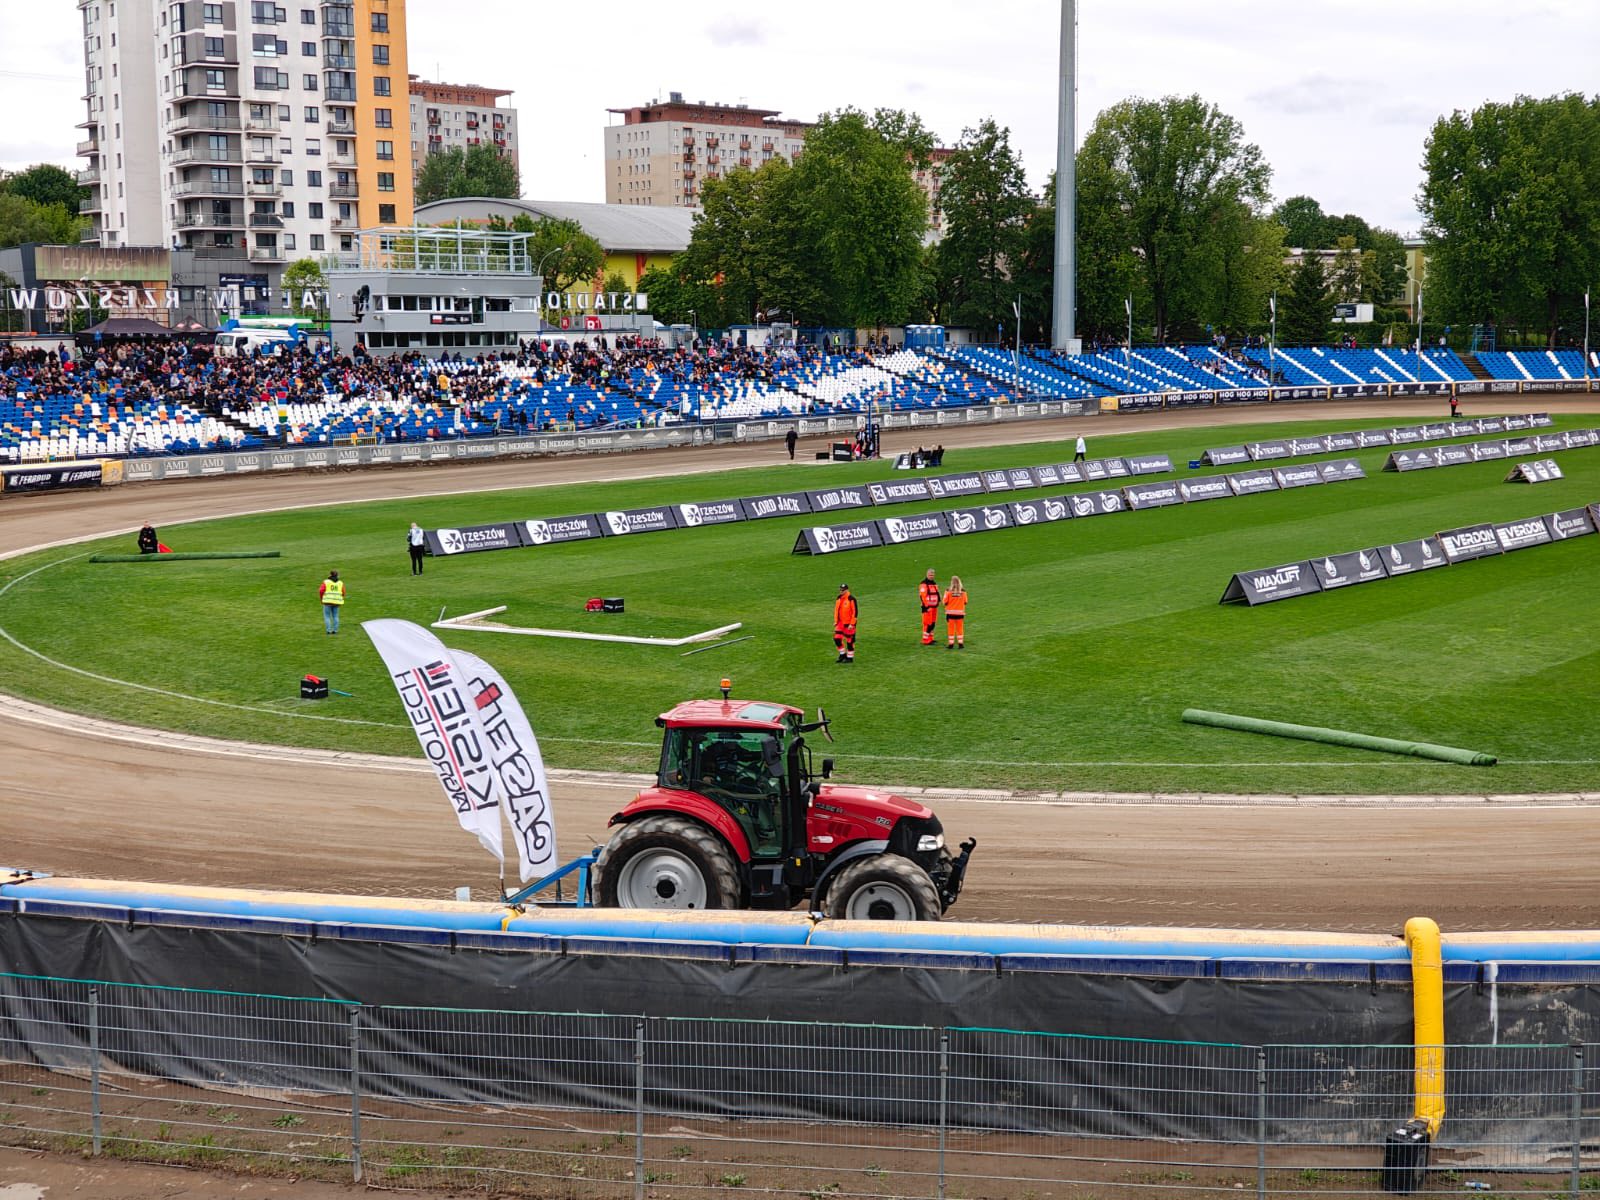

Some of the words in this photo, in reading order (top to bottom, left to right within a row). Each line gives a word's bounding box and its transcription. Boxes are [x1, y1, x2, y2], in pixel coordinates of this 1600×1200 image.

[62, 253, 123, 275] calypso
[338, 450, 359, 459] AMD
[371, 448, 391, 457] AMD
[401, 446, 421, 456] AMD
[431, 445, 449, 454] AMD
[236, 456, 258, 466] AMD
[273, 454, 294, 464] AMD
[306, 452, 327, 462] AMD
[129, 463, 150, 473] AMD
[166, 461, 188, 471] AMD
[202, 458, 224, 468] AMD
[1086, 462, 1101, 473] AMD
[1107, 460, 1122, 470] AMD
[1012, 469, 1029, 481] AMD
[1038, 467, 1055, 478] AMD
[1061, 464, 1077, 475] AMD
[987, 472, 1006, 483] AMD
[943, 477, 981, 491] NEXORIS
[886, 483, 927, 498] NEXORIS
[817, 495, 840, 509] LORD
[841, 489, 862, 505] JACK
[700, 504, 734, 516] rzeszów
[751, 499, 776, 516] LORD
[777, 496, 800, 512] JACK
[628, 511, 664, 524] rzeszów
[549, 519, 588, 533] rzeszów
[905, 518, 938, 531] rzeszów
[1504, 520, 1545, 538] VERDON
[462, 528, 505, 543] rzeszów
[834, 527, 869, 541] rzeszów
[1451, 528, 1495, 547] VERDON
[1254, 569, 1300, 589] MAXLIFT
